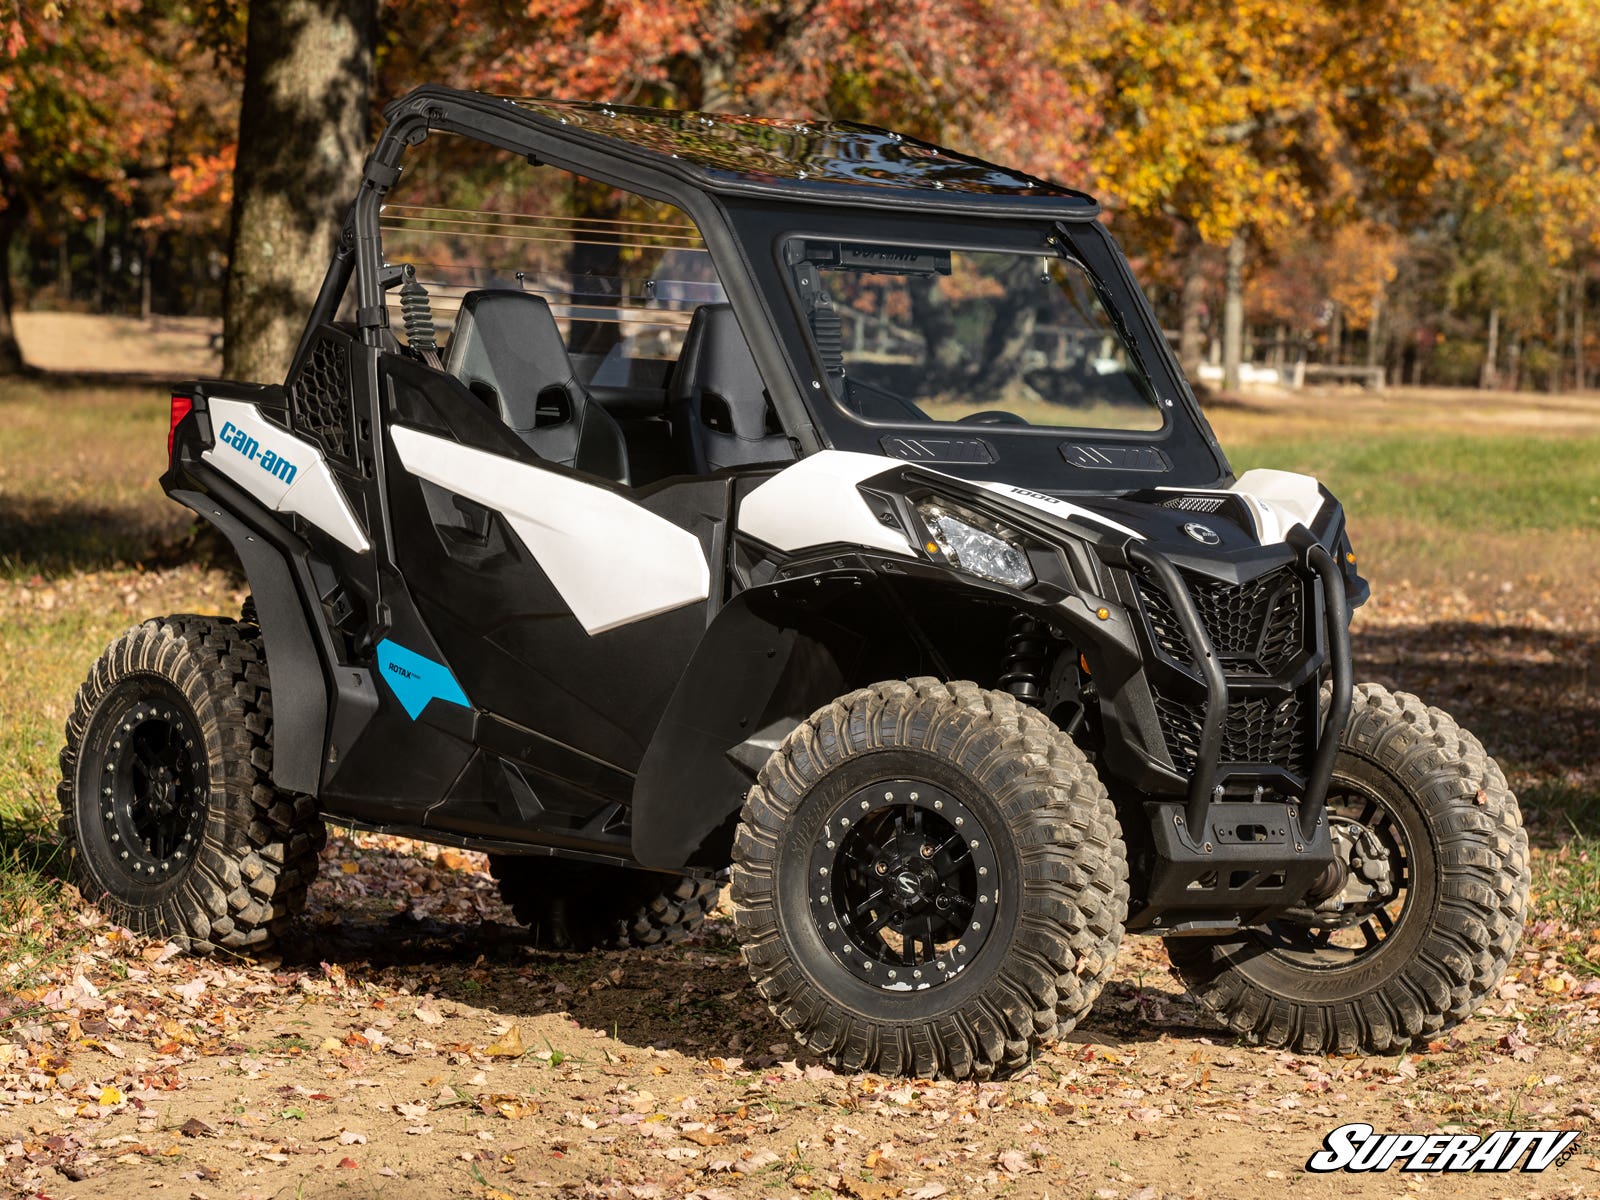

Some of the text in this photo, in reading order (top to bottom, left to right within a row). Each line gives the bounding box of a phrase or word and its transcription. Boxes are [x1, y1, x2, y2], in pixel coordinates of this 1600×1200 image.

[219, 421, 297, 485] can-am
[1011, 488, 1060, 504] 1000
[389, 662, 412, 679] ROTAX
